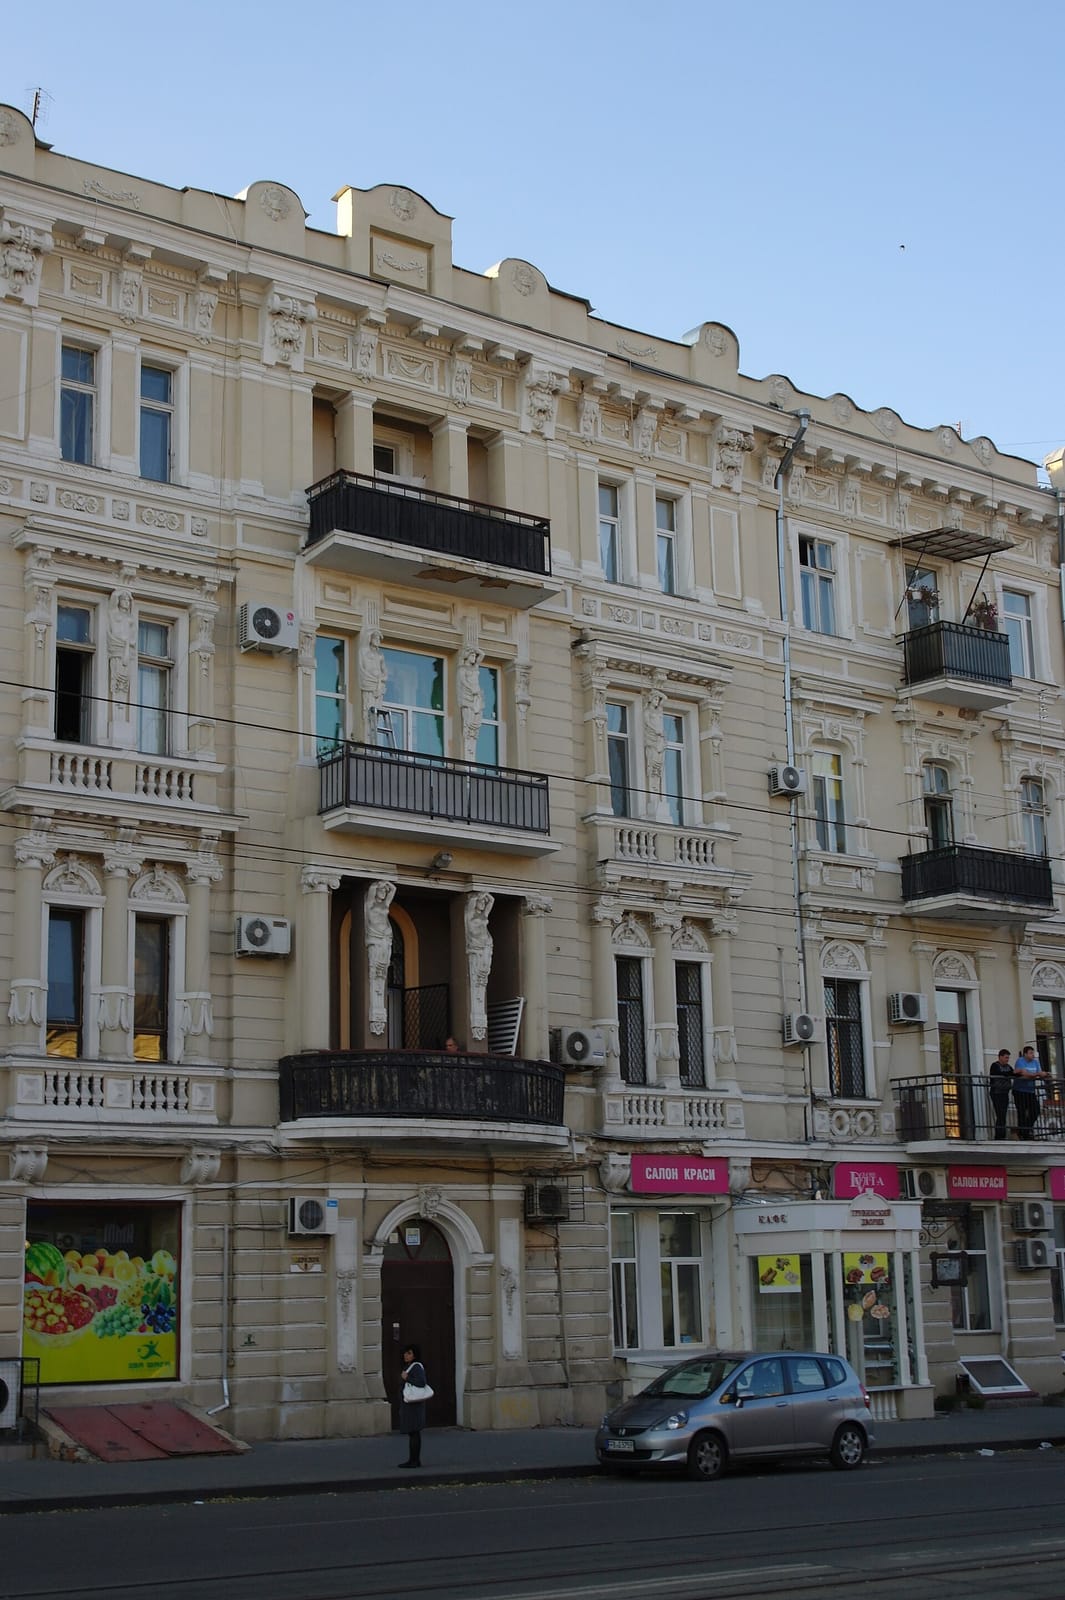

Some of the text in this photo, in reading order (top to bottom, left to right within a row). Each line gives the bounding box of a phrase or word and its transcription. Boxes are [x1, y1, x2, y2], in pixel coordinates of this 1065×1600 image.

[645, 1167, 716, 1181] САЛОН КРАСИ
[952, 1176, 1005, 1188] САЛОН КРАСИ
[758, 1214, 788, 1224] КАФЕ
